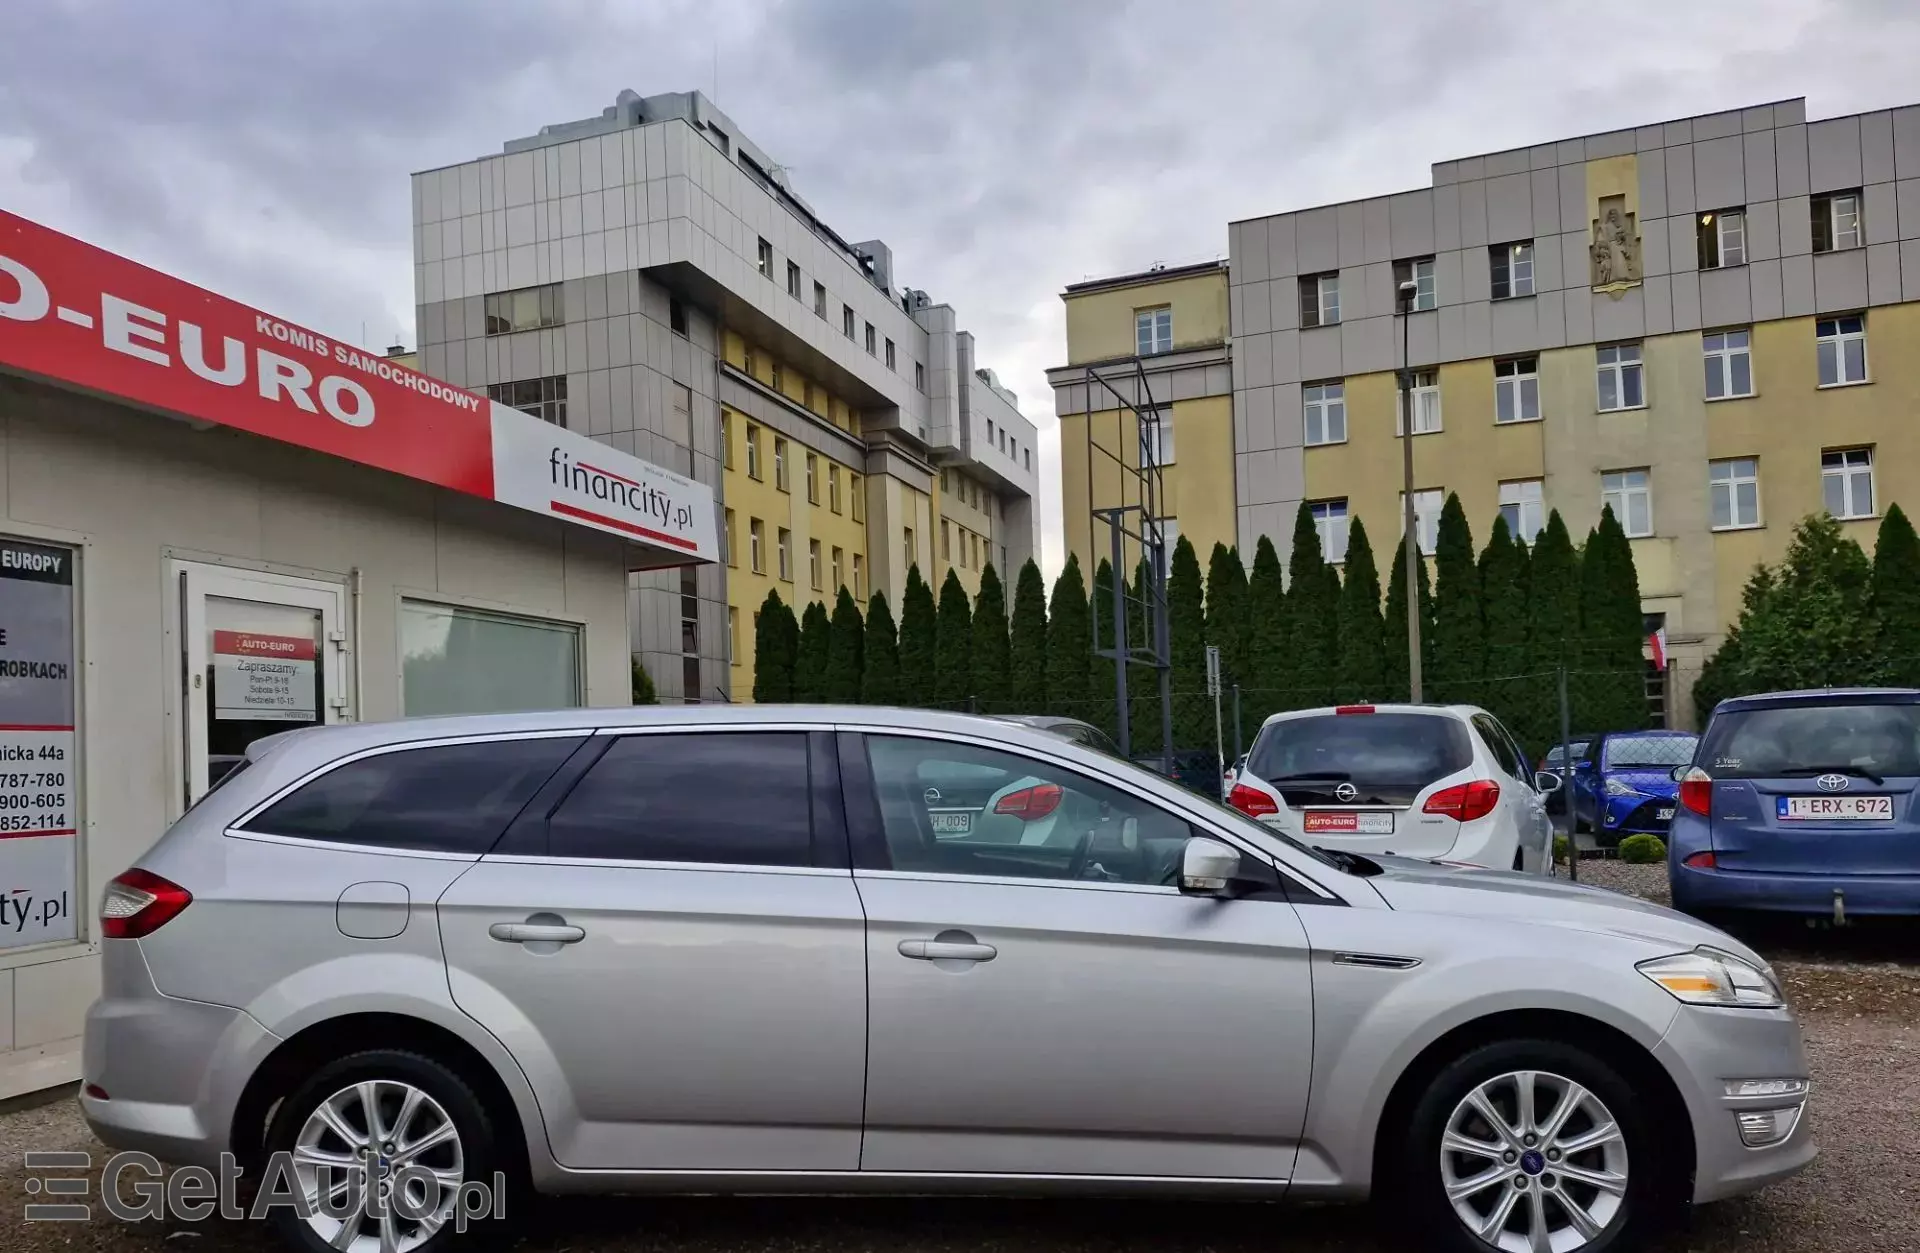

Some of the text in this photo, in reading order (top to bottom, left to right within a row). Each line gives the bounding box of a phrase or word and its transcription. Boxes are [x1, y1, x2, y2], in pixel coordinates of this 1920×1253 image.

[255, 314, 480, 413] KOMIS SAMOCHODOWY
[549, 447, 693, 530] financity.pl
[2, 550, 62, 574] EUROPY
[241, 639, 295, 652] AUTO-EURO
[237, 659, 297, 677] Zapraszamy
[0, 745, 64, 761] icka 44a
[0, 773, 65, 788] 787-780
[0, 793, 65, 809] 900-605
[0, 813, 66, 831] 852-114
[1309, 818, 1355, 826] AUTO-EURO
